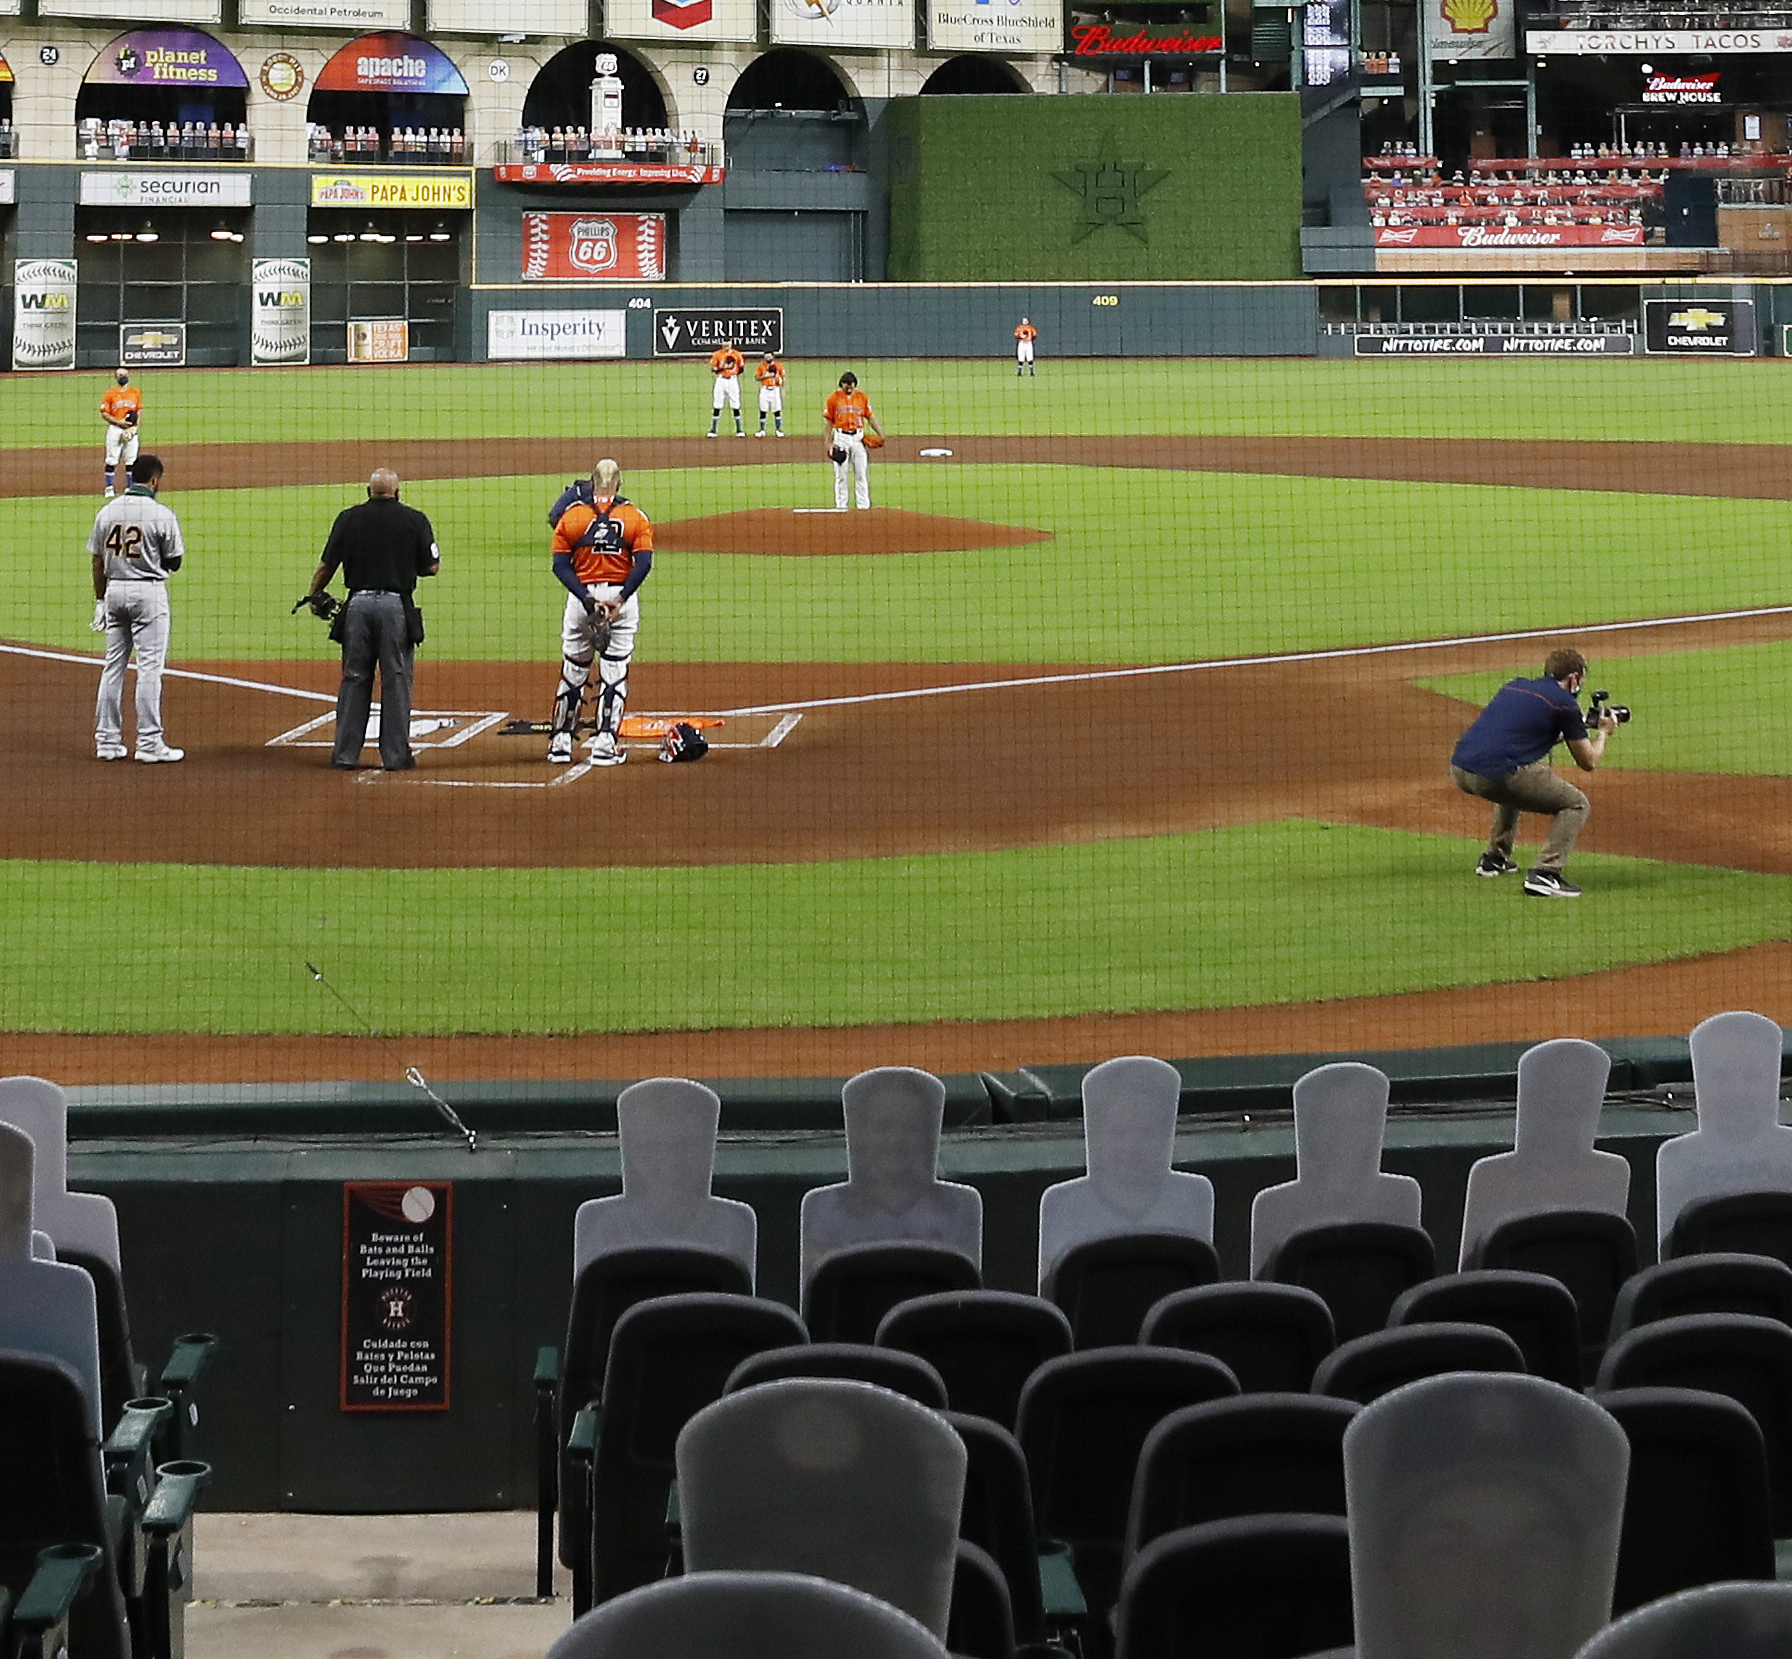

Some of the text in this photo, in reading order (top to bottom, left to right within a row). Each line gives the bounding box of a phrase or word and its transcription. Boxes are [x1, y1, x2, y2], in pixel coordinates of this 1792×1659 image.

[269, 4, 384, 18] Occidental Petroleum
[937, 12, 1056, 30] BlueCross BlueShield
[974, 32, 1022, 44] of Texas
[1070, 25, 1223, 56] Budweiser
[1692, 33, 1761, 49] TACOS
[145, 47, 208, 67] planet
[152, 63, 219, 82] fitness
[357, 55, 427, 79] apache
[1646, 76, 1714, 91] Budweiser
[1642, 91, 1721, 103] BREW HOUSE
[140, 179, 220, 195] securian
[371, 184, 466, 202] PAPA JOHN'S
[577, 226, 610, 236] PHILLIPS
[1458, 226, 1561, 246] Budweiser
[578, 241, 608, 261] 66
[628, 298, 651, 309] 404
[1092, 294, 1119, 308] 409
[520, 317, 606, 341] Insperity
[686, 320, 774, 338] VERITEX
[1382, 336, 1485, 355] NITTOTIRE.COM
[1502, 336, 1606, 354] NITTOTIRE.COM
[1667, 334, 1729, 349] CHEVROLET
[105, 523, 143, 560] 42
[372, 1232, 424, 1243] Beware of
[360, 1244, 434, 1254] Bats and Balls
[366, 1256, 428, 1269] Leaving the
[361, 1268, 432, 1280] Playing Field
[363, 1339, 429, 1349] Cuidado con
[356, 1351, 436, 1362] Bates y Pelotas
[363, 1363, 428, 1373] Que Puedan
[353, 1374, 438, 1386] Salir del Campo
[372, 1387, 419, 1398] de Juego
